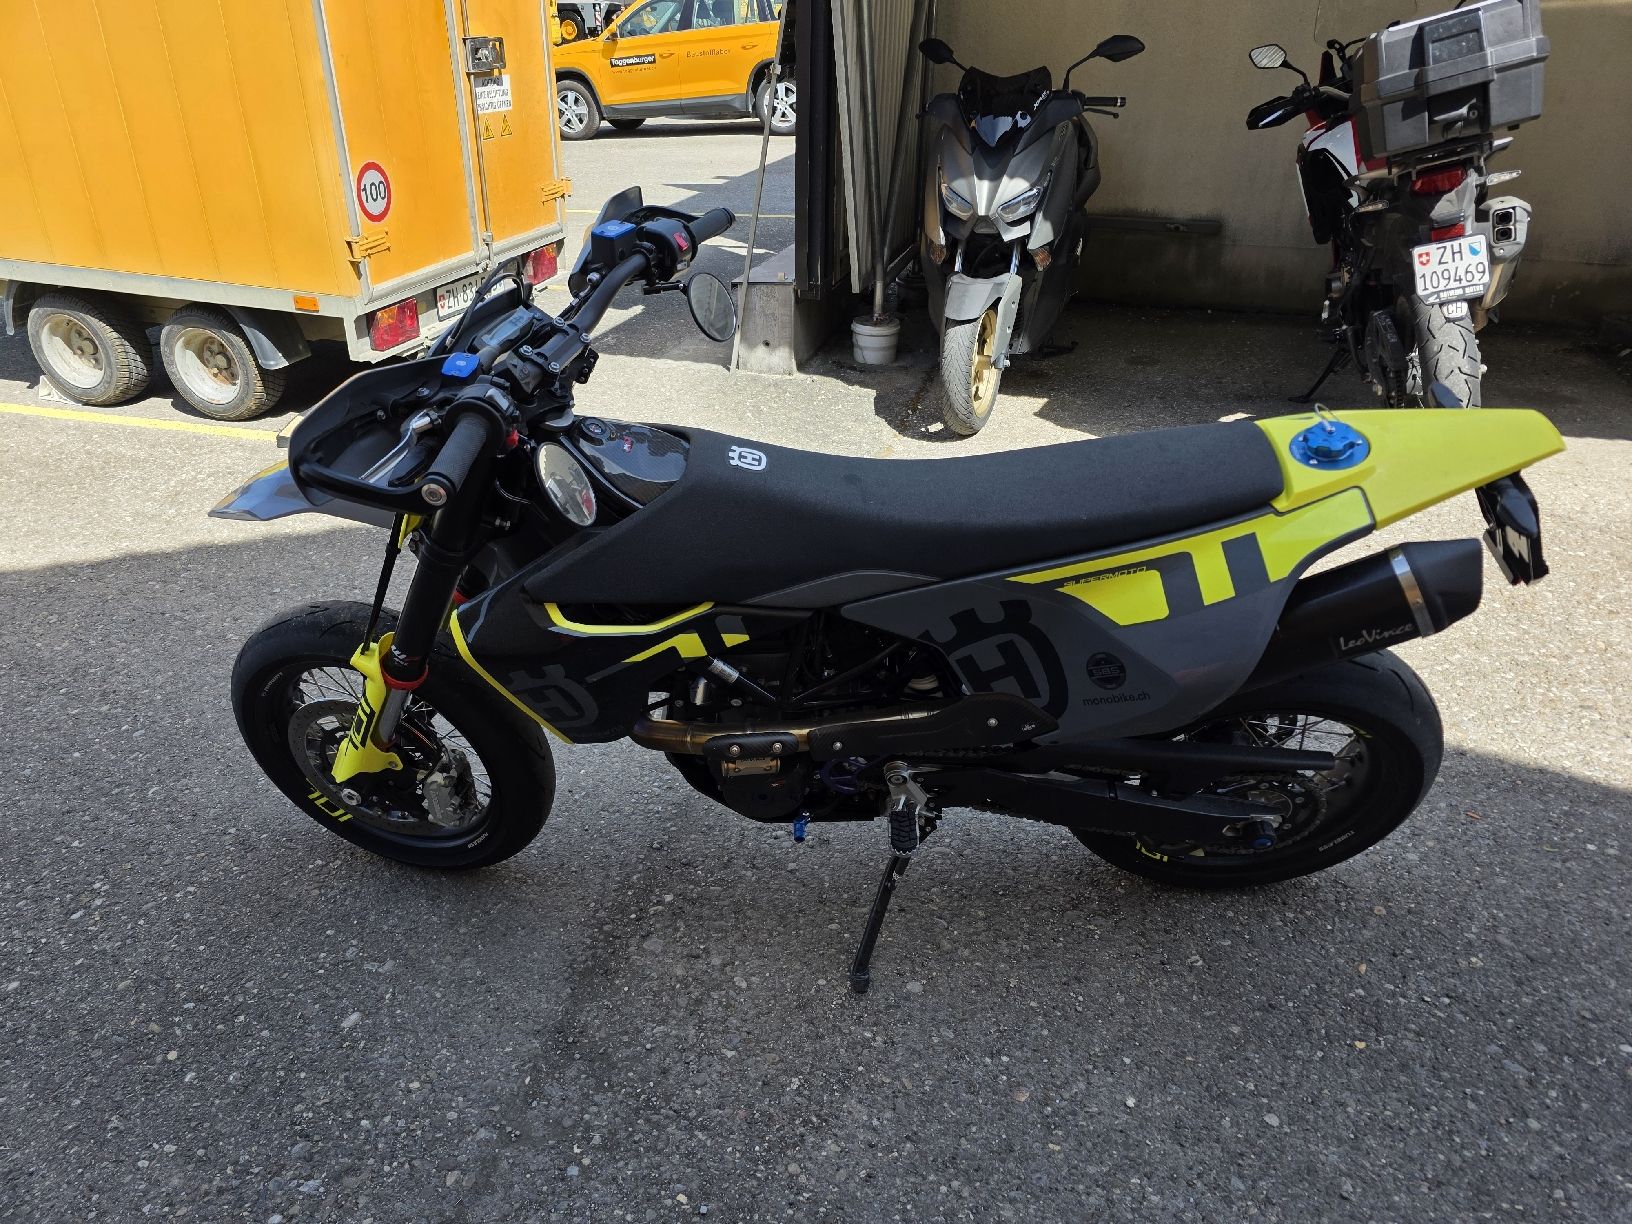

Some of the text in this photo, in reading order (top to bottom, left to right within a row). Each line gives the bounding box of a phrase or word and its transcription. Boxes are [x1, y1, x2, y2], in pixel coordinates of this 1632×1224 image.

[611, 55, 655, 67] Toggenburger
[361, 180, 387, 203] 100
[1436, 243, 1464, 266] ZH
[1419, 261, 1487, 292] 109469
[1446, 301, 1464, 315] CH
[1063, 565, 1147, 587] SUPERMOTO
[1339, 623, 1414, 651] LeoVince
[1082, 690, 1152, 707] monobike.ch
